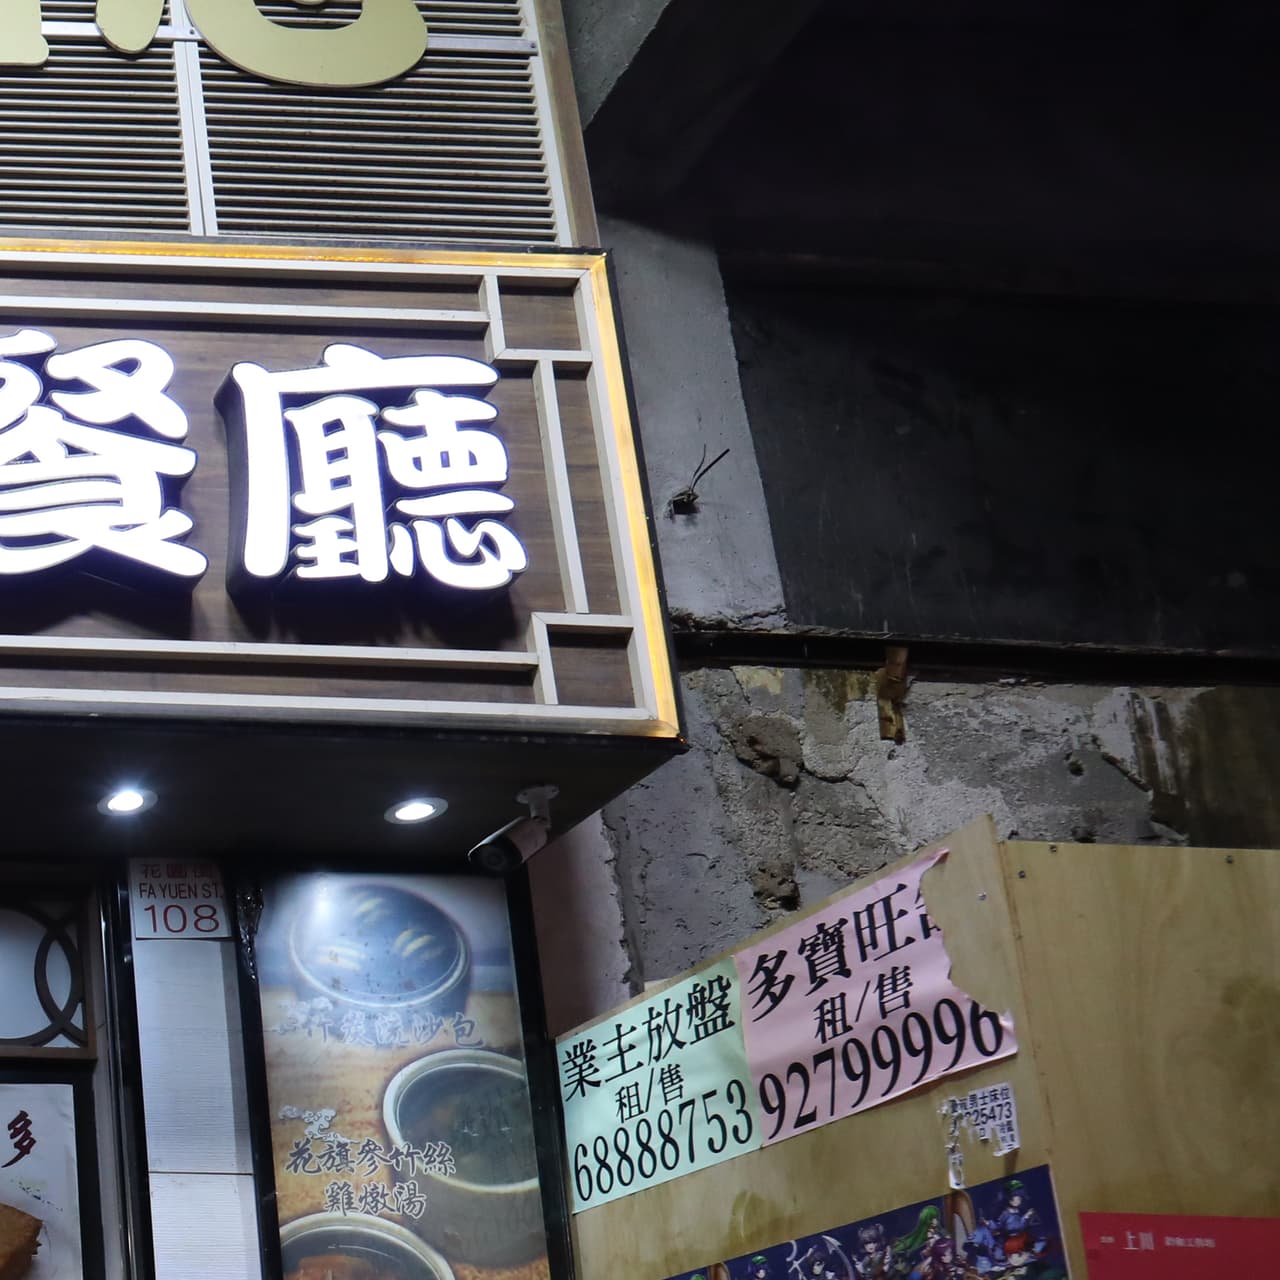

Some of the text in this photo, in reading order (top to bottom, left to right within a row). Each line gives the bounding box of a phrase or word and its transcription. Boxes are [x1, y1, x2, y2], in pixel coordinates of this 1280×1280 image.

[139, 883, 157, 898] FA
[159, 883, 198, 899] YUEN
[143, 904, 220, 933] 108
[814, 965, 913, 1045] 租/售
[563, 974, 737, 1102] 業主放盤
[614, 1063, 686, 1124] 租/售
[759, 998, 1005, 1141] 92799996
[285, 1137, 457, 1178] 花旗參竹絲
[573, 1077, 754, 1203] 68888753
[323, 1180, 428, 1220] 雞燉湯
